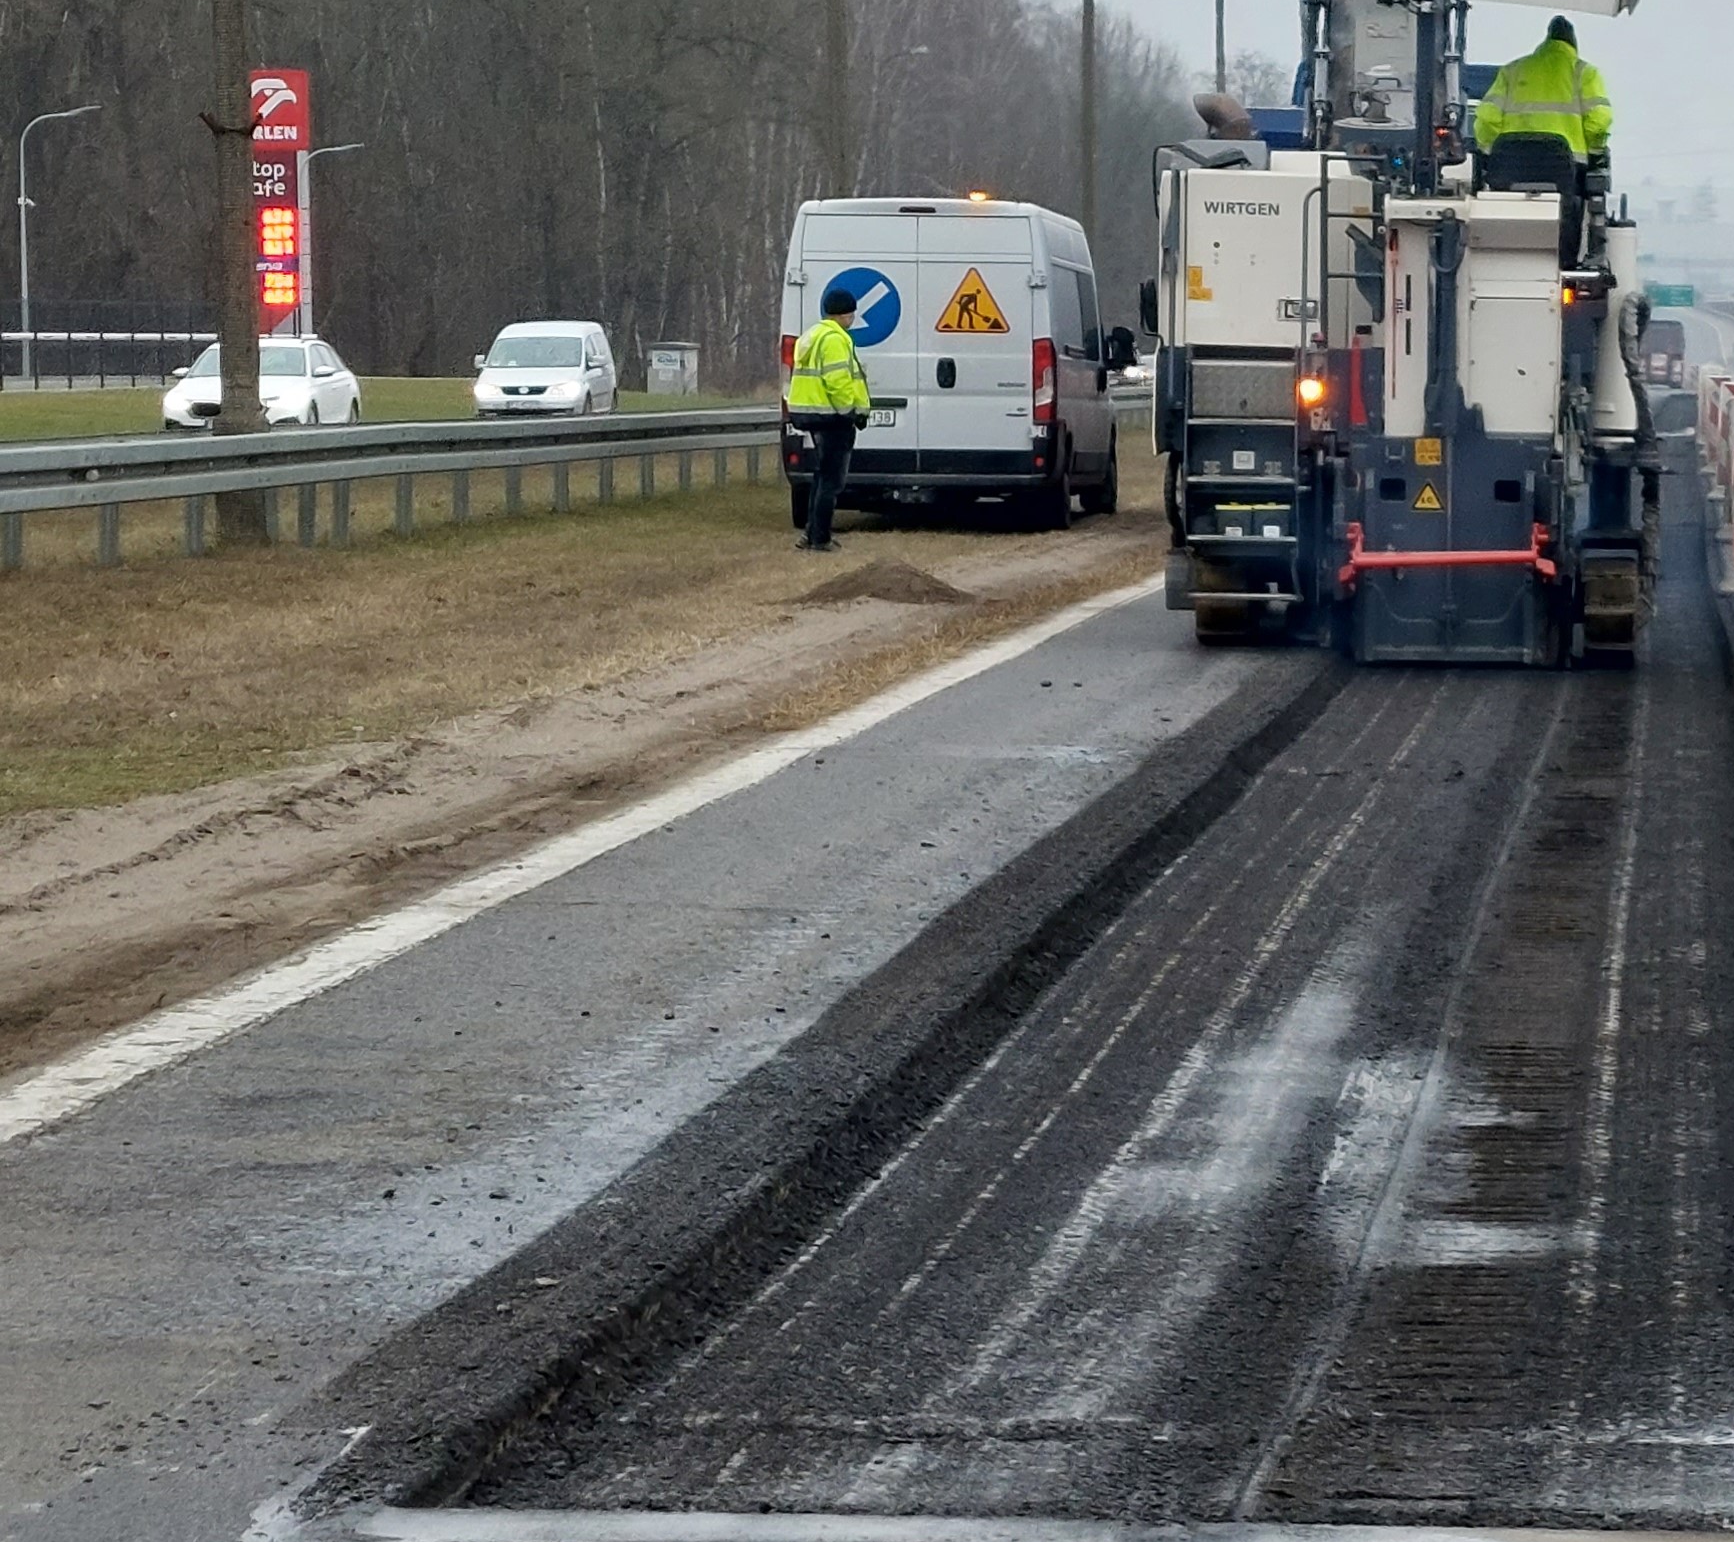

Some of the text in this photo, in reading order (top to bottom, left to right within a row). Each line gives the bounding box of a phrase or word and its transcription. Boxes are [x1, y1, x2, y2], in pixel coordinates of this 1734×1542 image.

[252, 125, 297, 140] RLEN
[253, 161, 285, 181] top
[253, 179, 286, 197] afe
[1204, 201, 1280, 216] WIRTGEN
